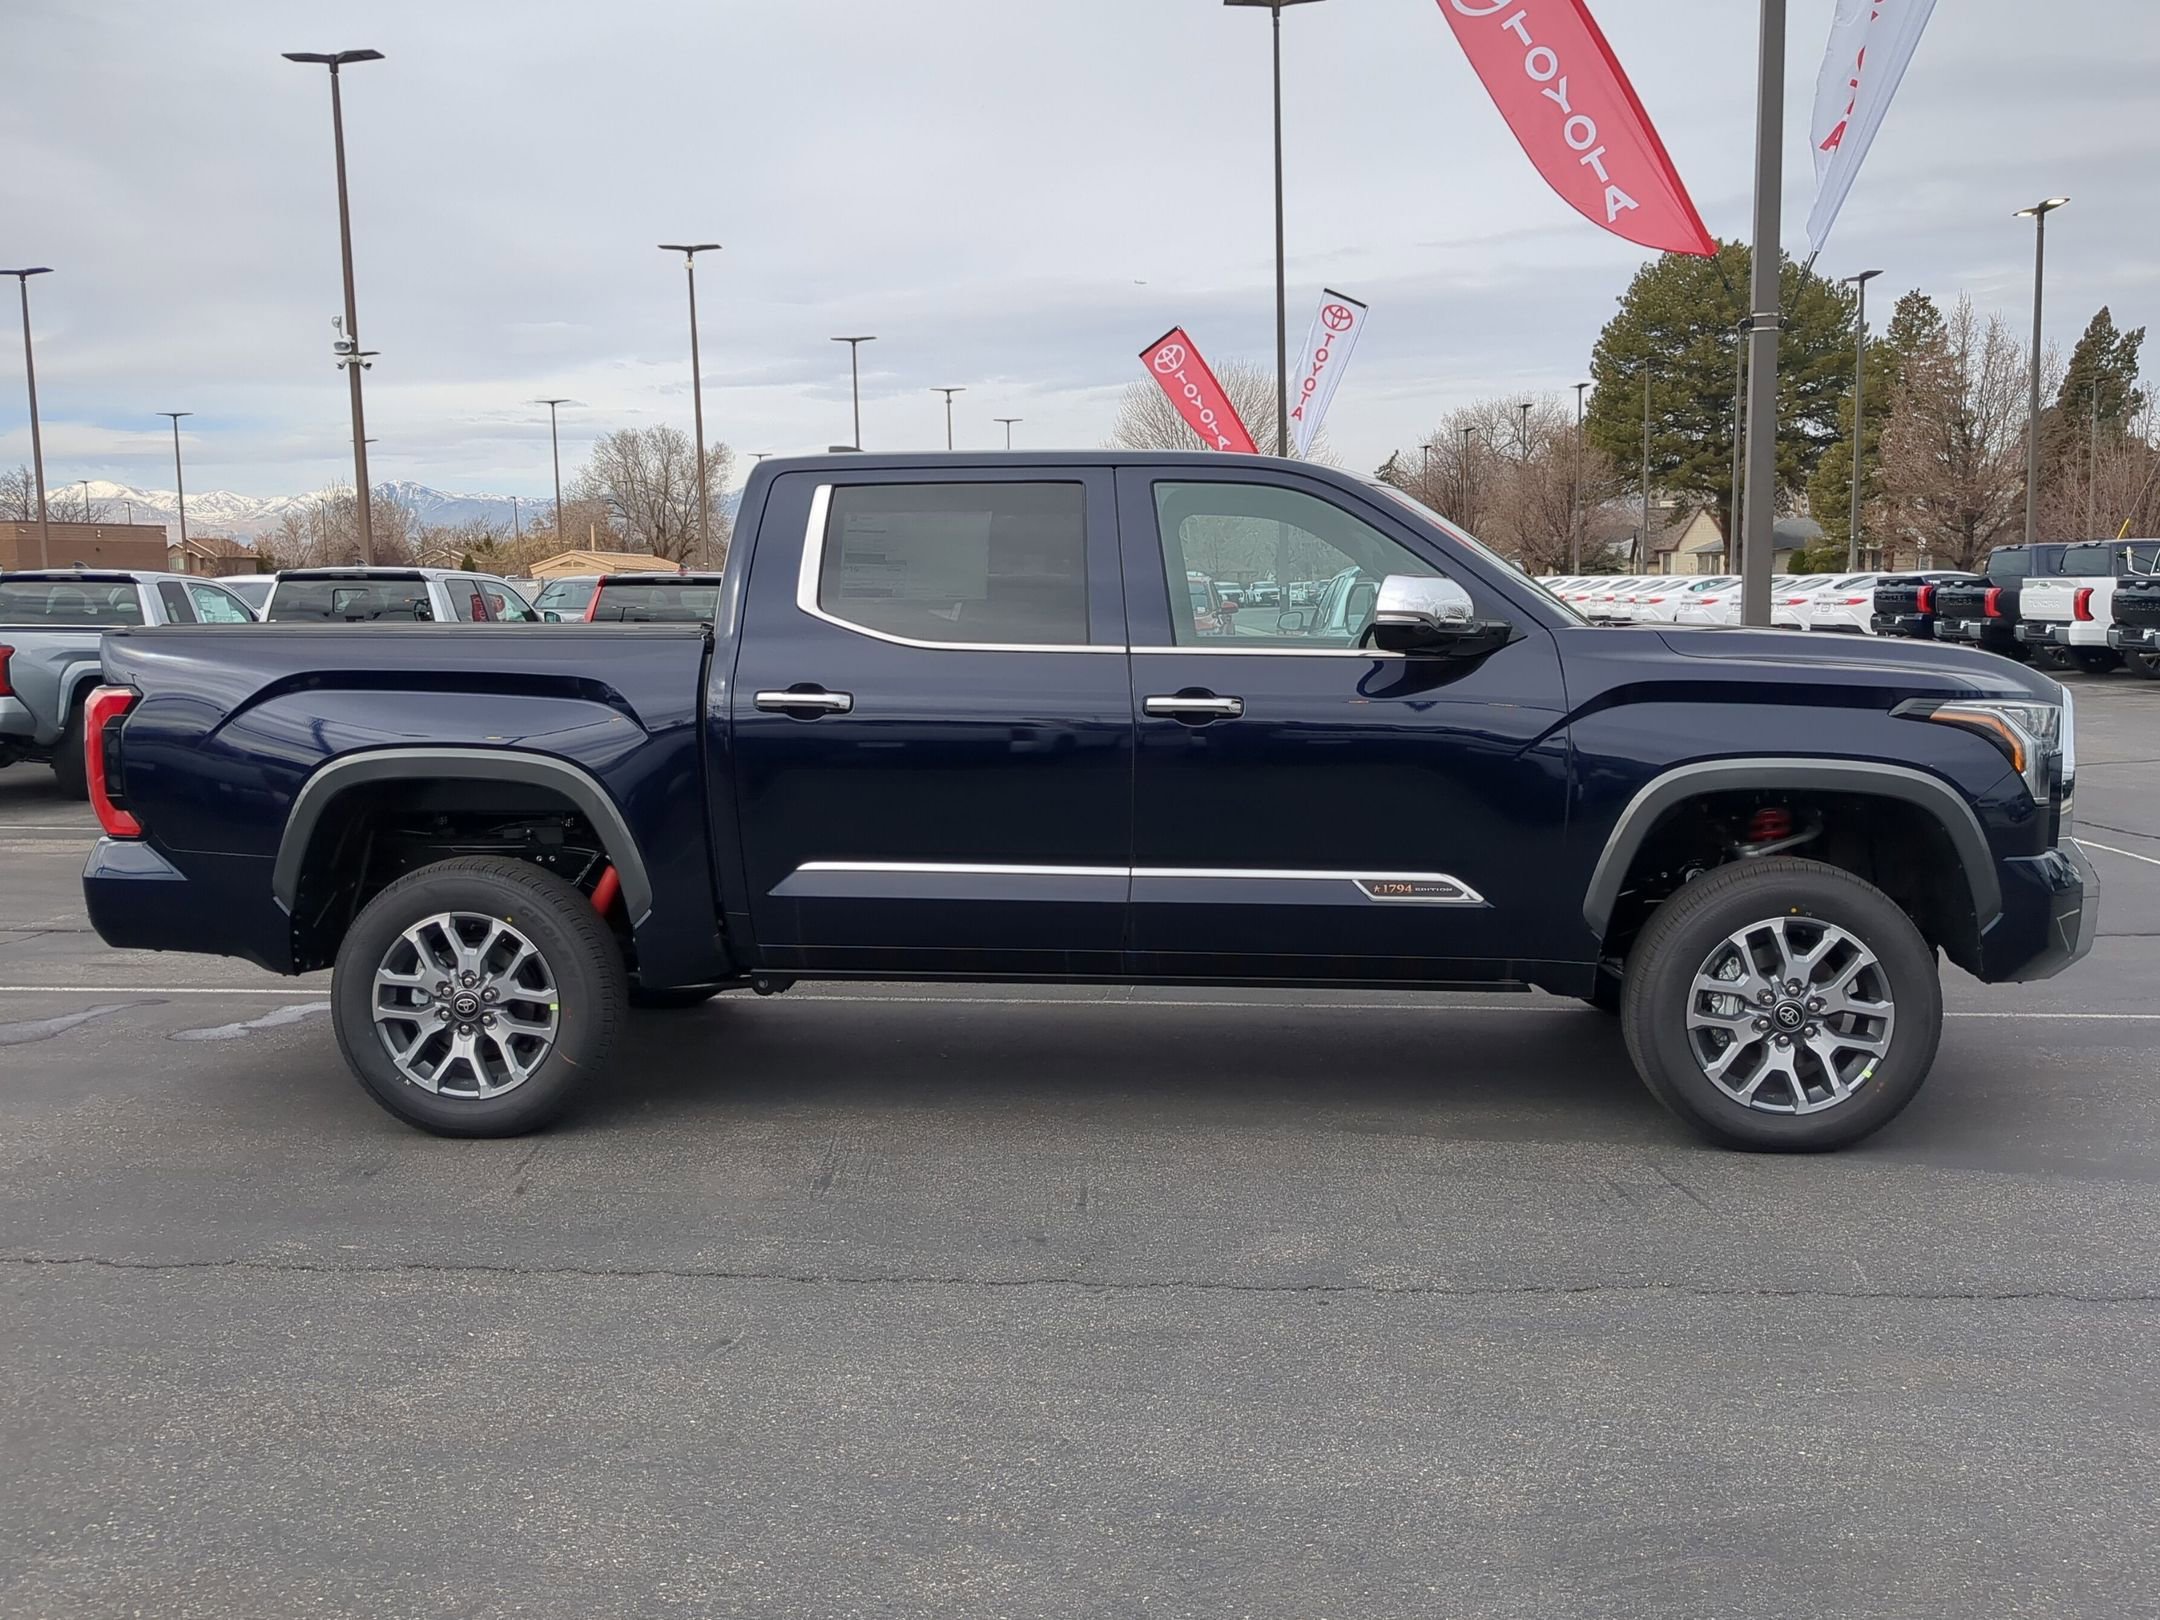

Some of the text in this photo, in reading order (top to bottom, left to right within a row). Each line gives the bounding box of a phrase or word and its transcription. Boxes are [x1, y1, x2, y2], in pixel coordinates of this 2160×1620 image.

[1501, 9, 1640, 223] TOYOTA
[1174, 369, 1232, 451] TOYOTA
[1290, 332, 1335, 421] TOYOTA
[2028, 599, 2061, 609] TUNDRA
[1382, 884, 1412, 893] 1794
